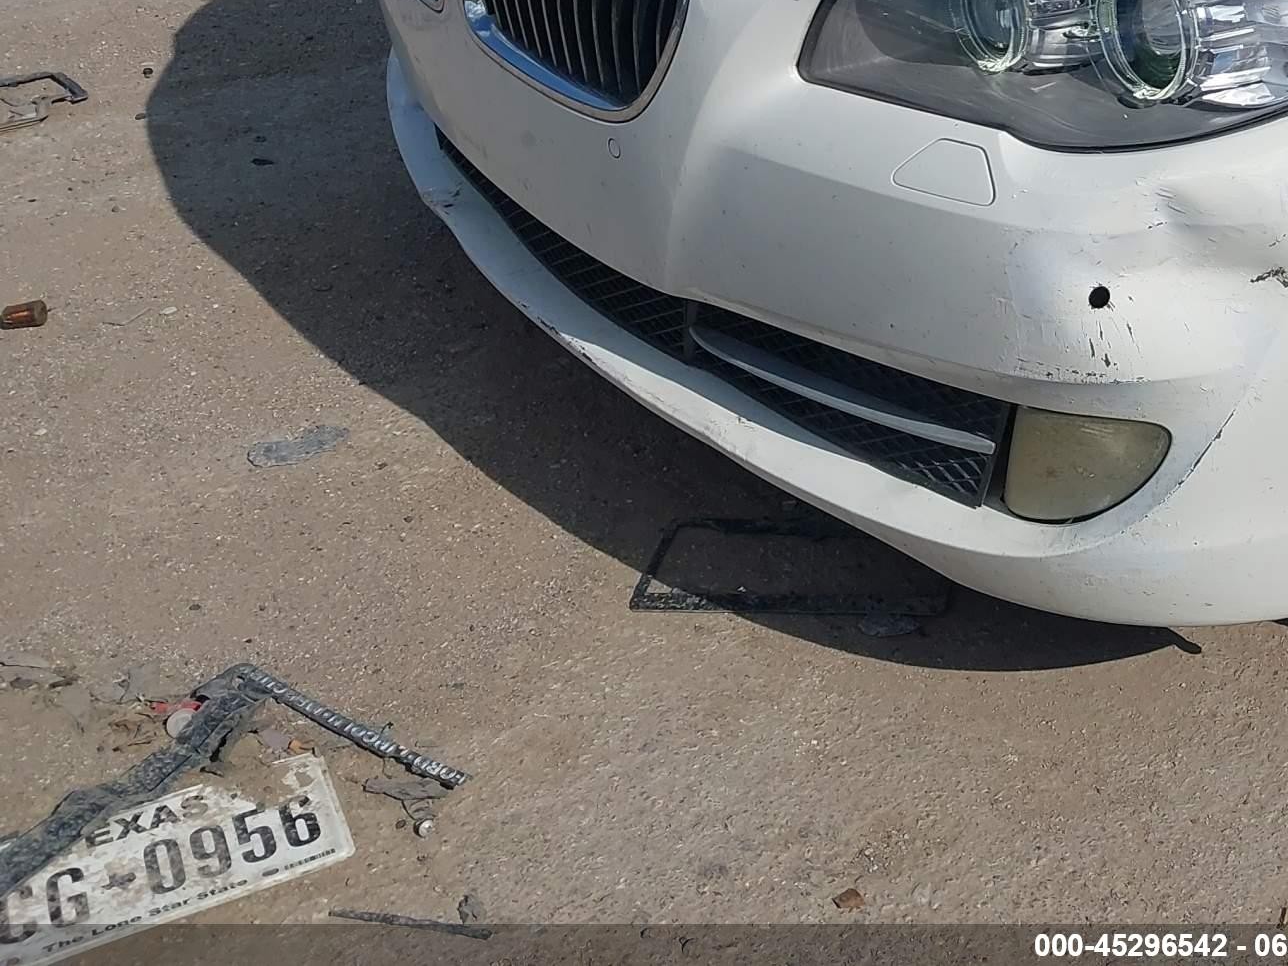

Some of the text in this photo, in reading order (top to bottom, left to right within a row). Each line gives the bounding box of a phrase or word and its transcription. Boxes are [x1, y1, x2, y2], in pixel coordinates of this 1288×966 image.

[85, 795, 209, 849] EXAS
[42, 878, 249, 953] The Lone Star State
